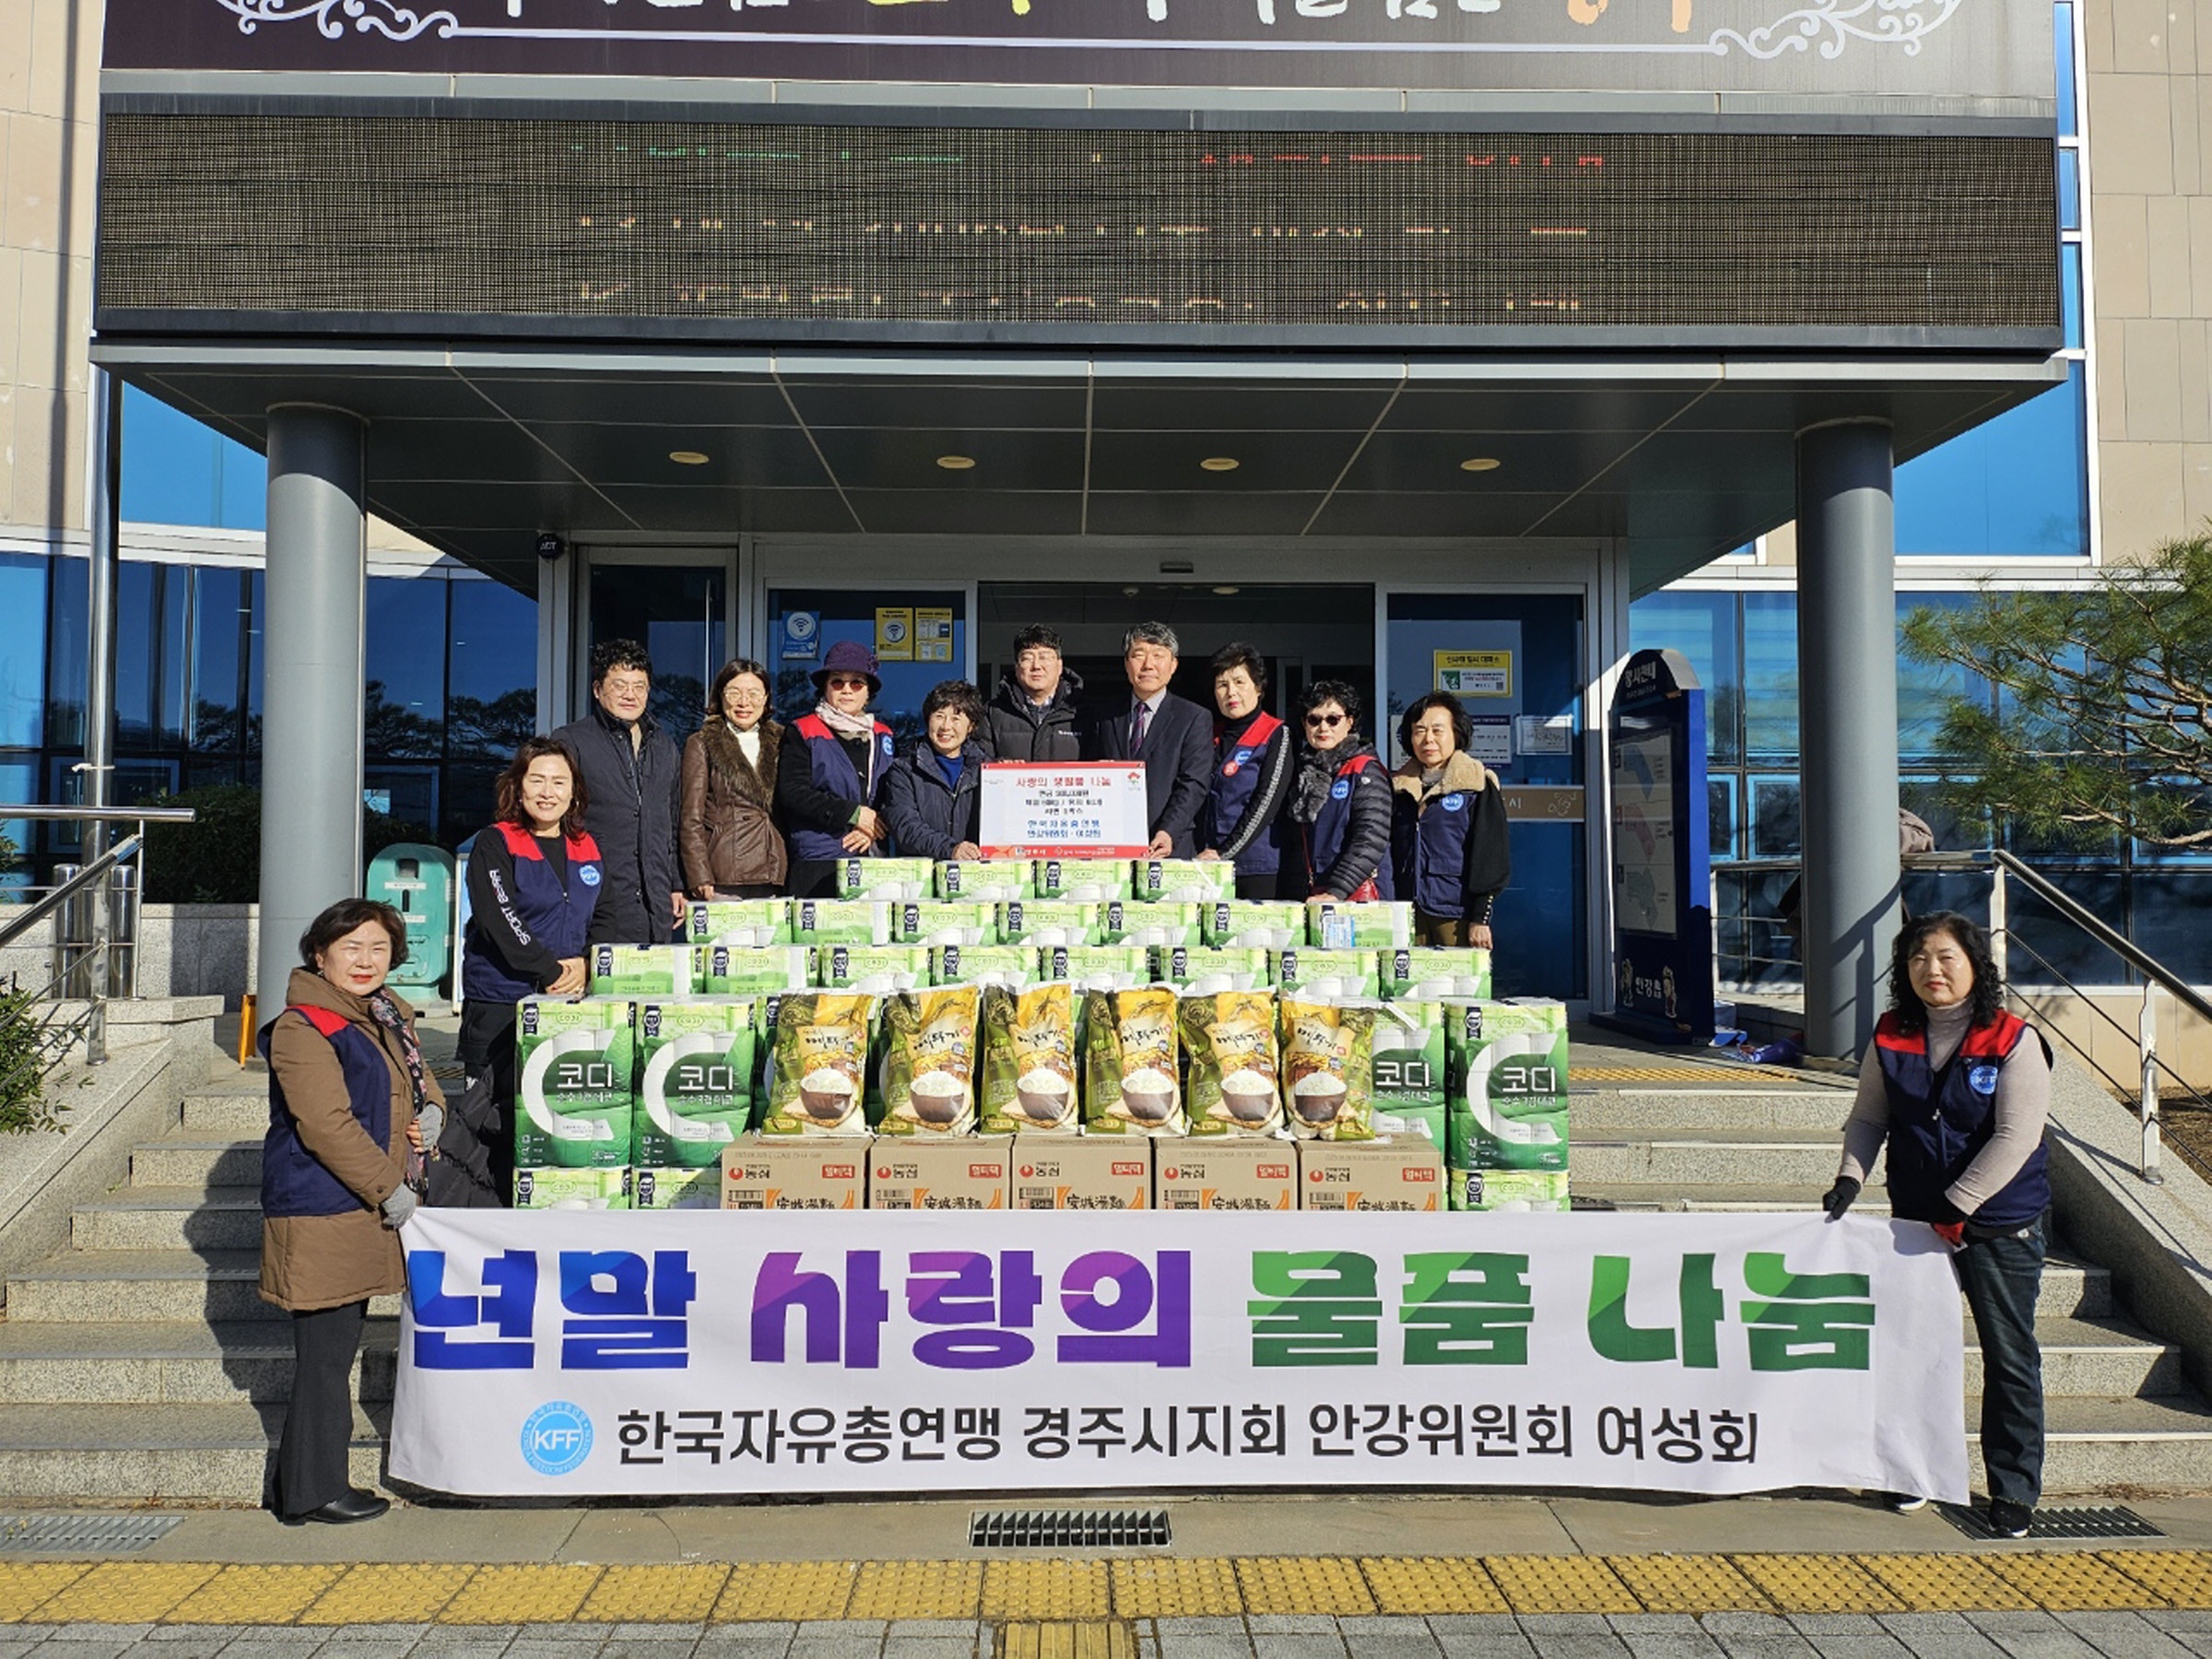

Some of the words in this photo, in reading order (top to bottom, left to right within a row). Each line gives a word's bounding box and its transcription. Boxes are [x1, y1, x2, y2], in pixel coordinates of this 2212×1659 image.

[1016, 777, 1048, 788] 사랑의
[500, 906, 532, 946] SPORT
[557, 1064, 612, 1088] 코디
[678, 1065, 733, 1090] 코디
[1376, 1061, 1430, 1087] 코디
[1502, 1066, 1556, 1092] 코디
[745, 1169, 771, 1180] 농심
[892, 1169, 918, 1179] 농심
[1035, 1166, 1060, 1177] 농심
[1180, 1169, 1205, 1179] 농심
[1325, 1171, 1350, 1182] 농심
[407, 1249, 697, 1370] 년말
[750, 1250, 1191, 1370] 사랑의
[1247, 1251, 1535, 1367] 물품
[1587, 1252, 1876, 1371] 나눔
[535, 1430, 582, 1450] KFF
[618, 1406, 1001, 1465] 한국자유총연맹
[1023, 1405, 1287, 1459] 경주시지회
[1309, 1404, 1572, 1458] 안강위원회
[1597, 1406, 1759, 1464] 여성회
